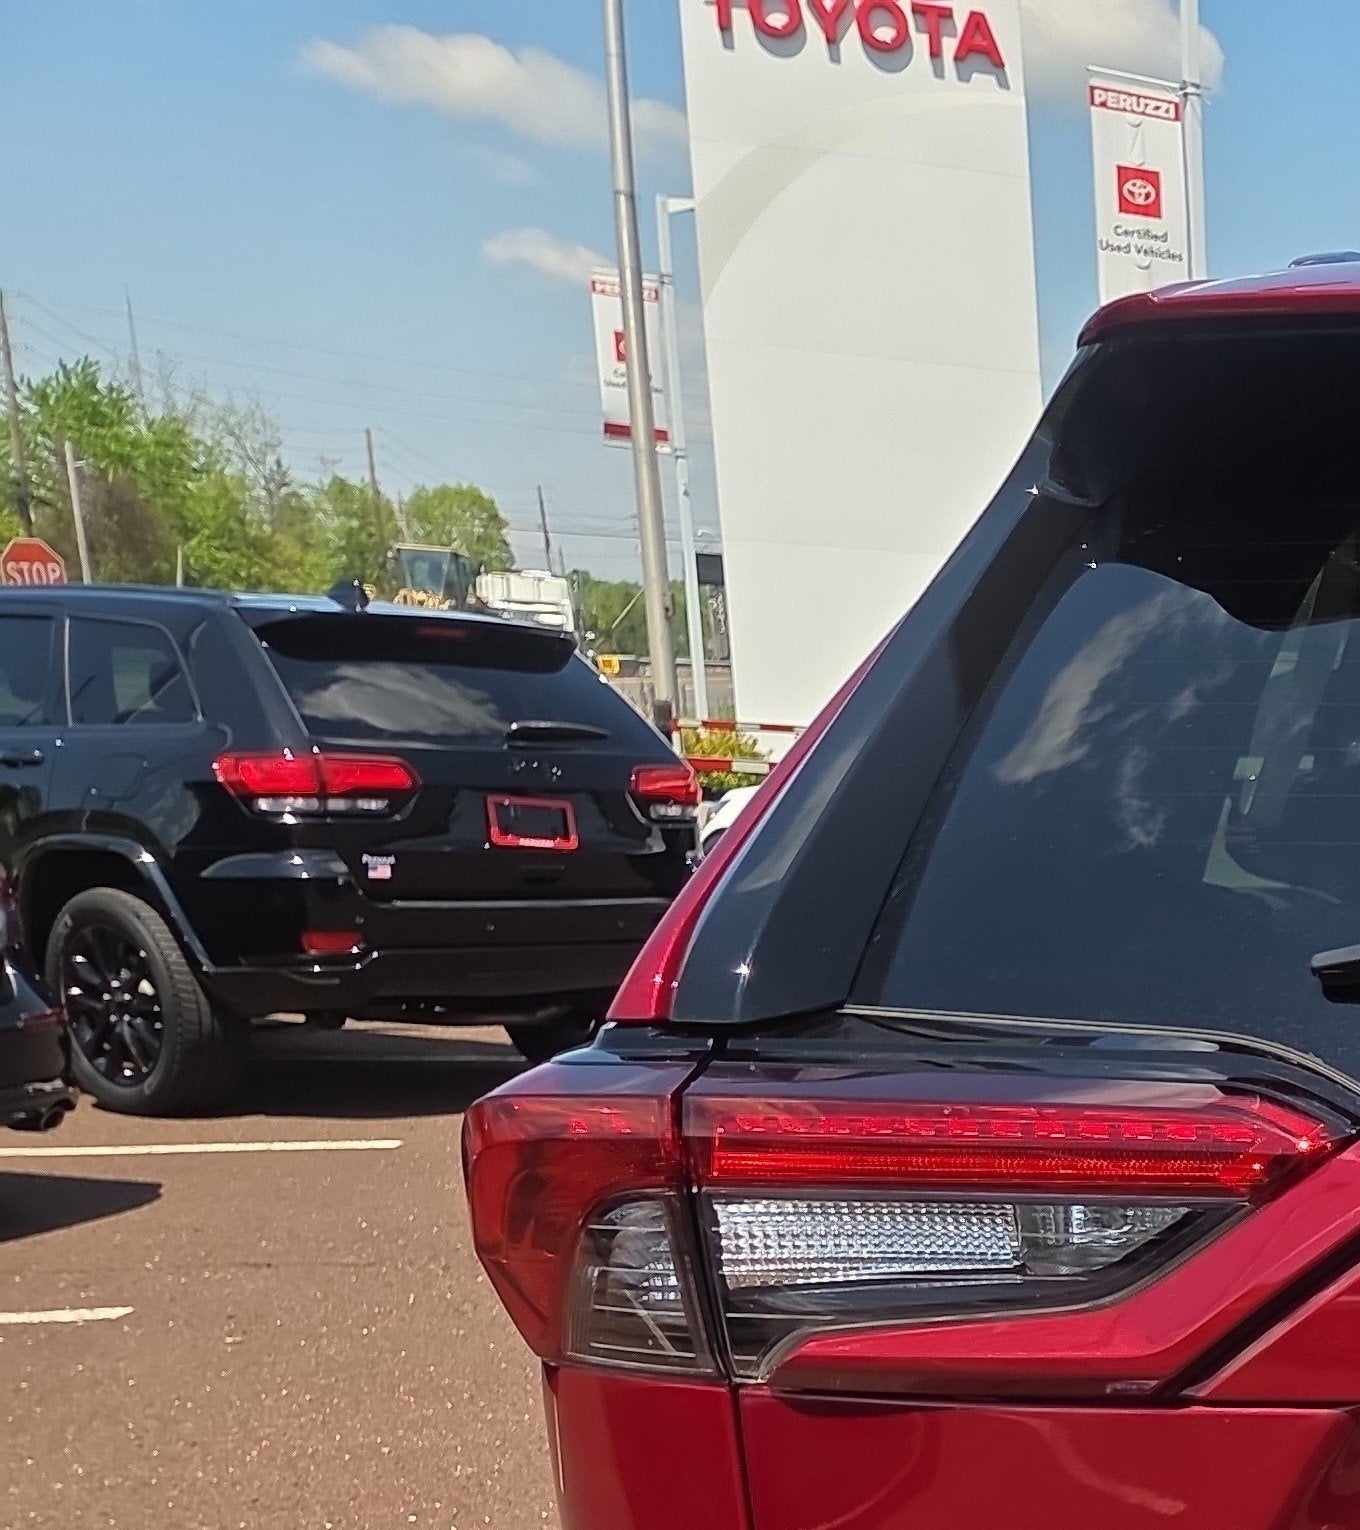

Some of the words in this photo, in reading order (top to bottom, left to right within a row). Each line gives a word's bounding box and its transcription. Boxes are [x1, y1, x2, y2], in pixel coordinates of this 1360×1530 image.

[1093, 88, 1176, 120] PERUZZI
[1113, 224, 1168, 243] Certified
[1099, 239, 1132, 254] Used
[1133, 242, 1184, 263] Vehicles
[6, 560, 61, 587] STOP
